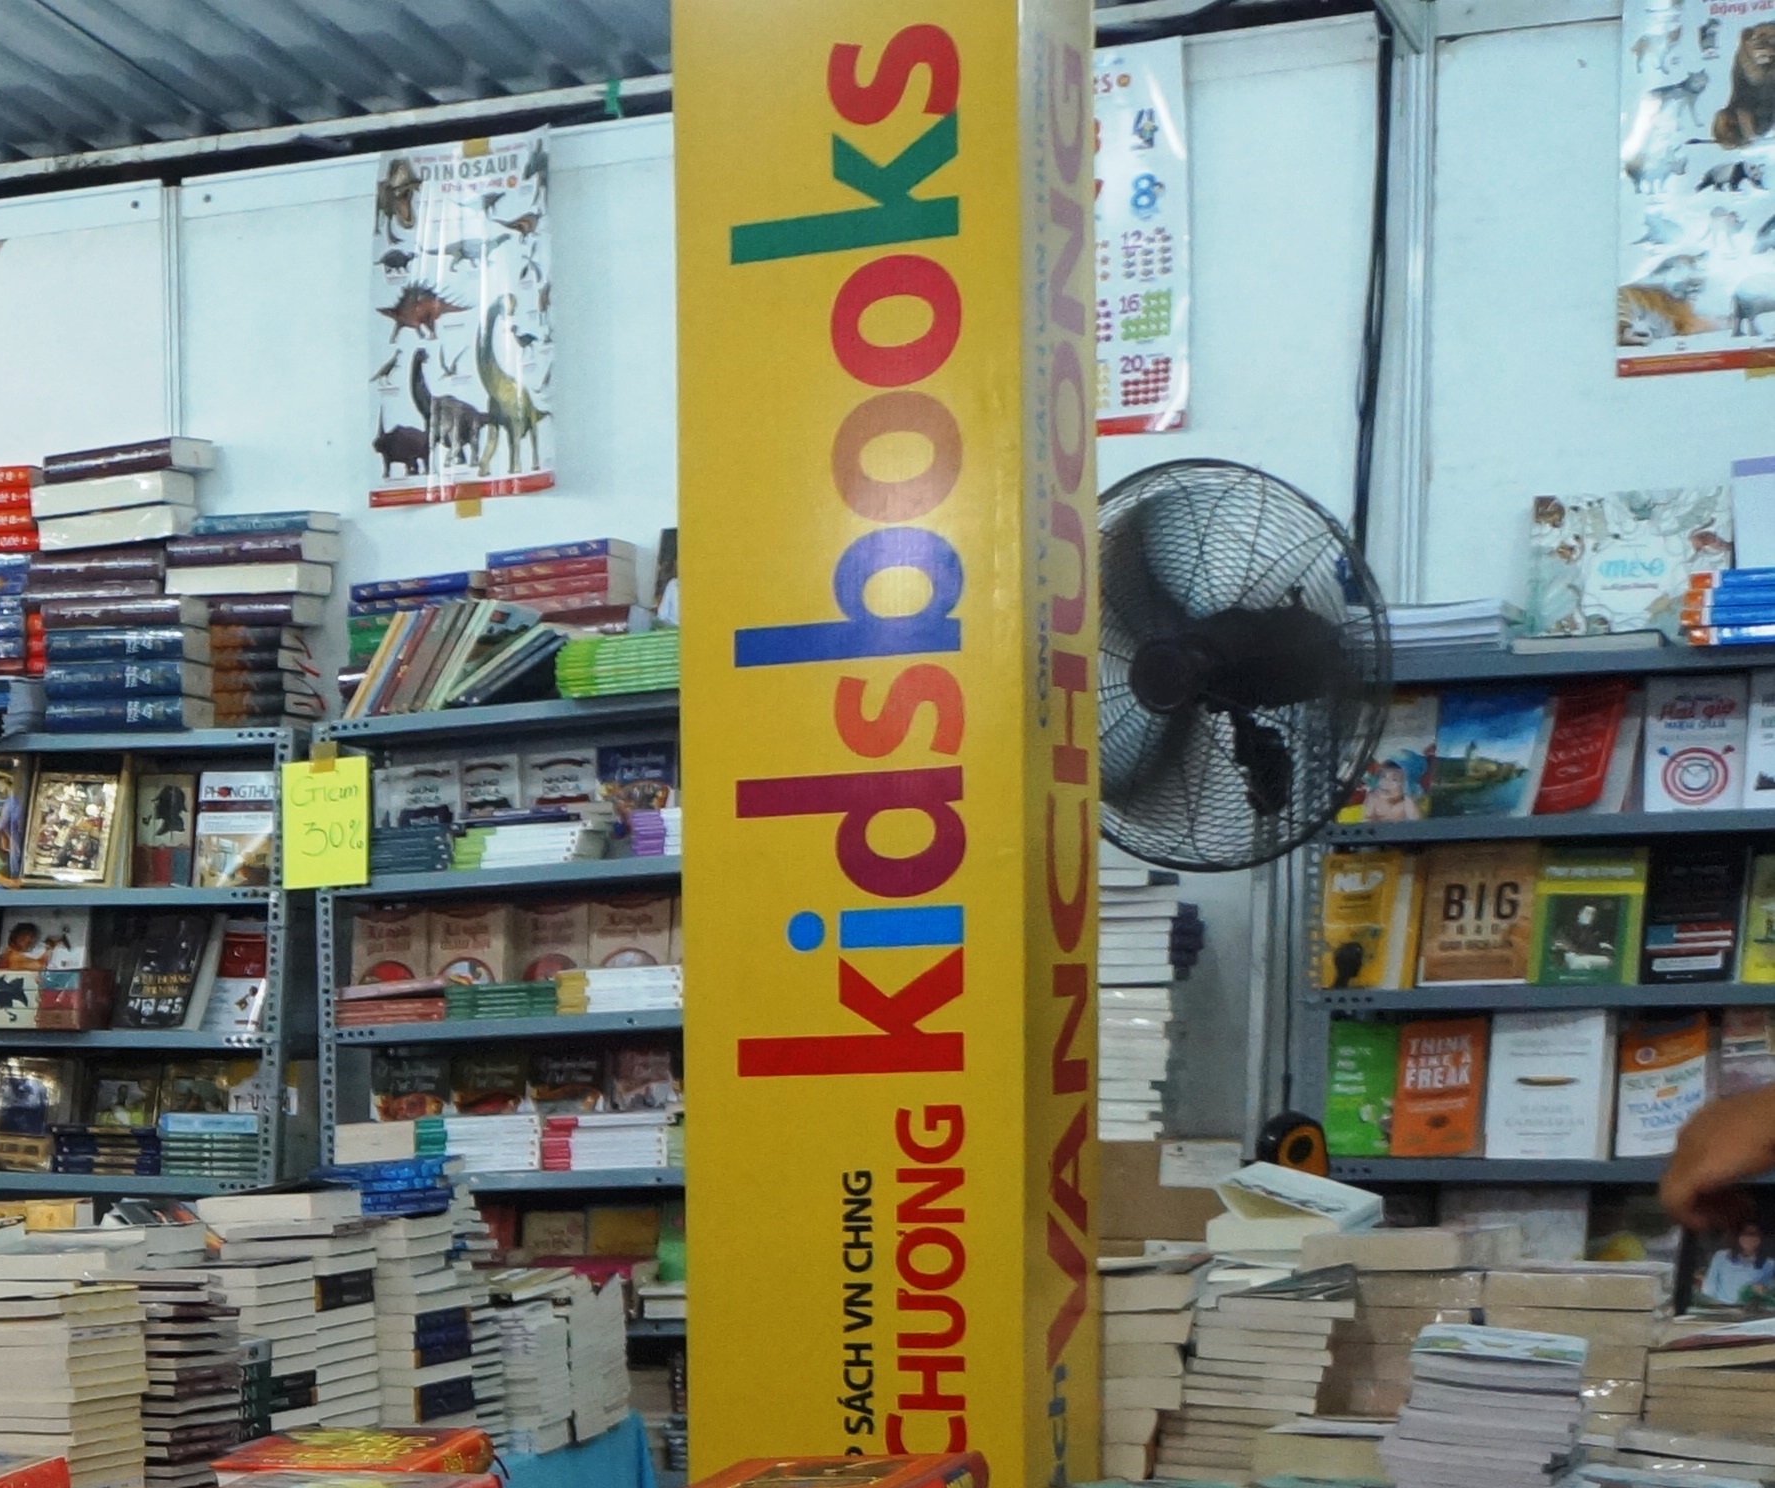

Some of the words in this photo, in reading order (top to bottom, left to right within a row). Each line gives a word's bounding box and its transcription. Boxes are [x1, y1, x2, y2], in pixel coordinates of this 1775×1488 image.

[419, 153, 519, 182] DINOSAUR
[1132, 172, 1157, 218] 8
[1120, 293, 1141, 313] 16
[1120, 354, 1144, 375] 20
[730, 23, 966, 1077] kidsbooks
[1441, 880, 1520, 922] BIG
[1408, 1035, 1472, 1055] THINK
[1404, 1066, 1473, 1090] FREAK
[841, 1170, 873, 1275] CHNG
[842, 1286, 874, 1334] VN
[836, 1340, 875, 1437] SÁCH
